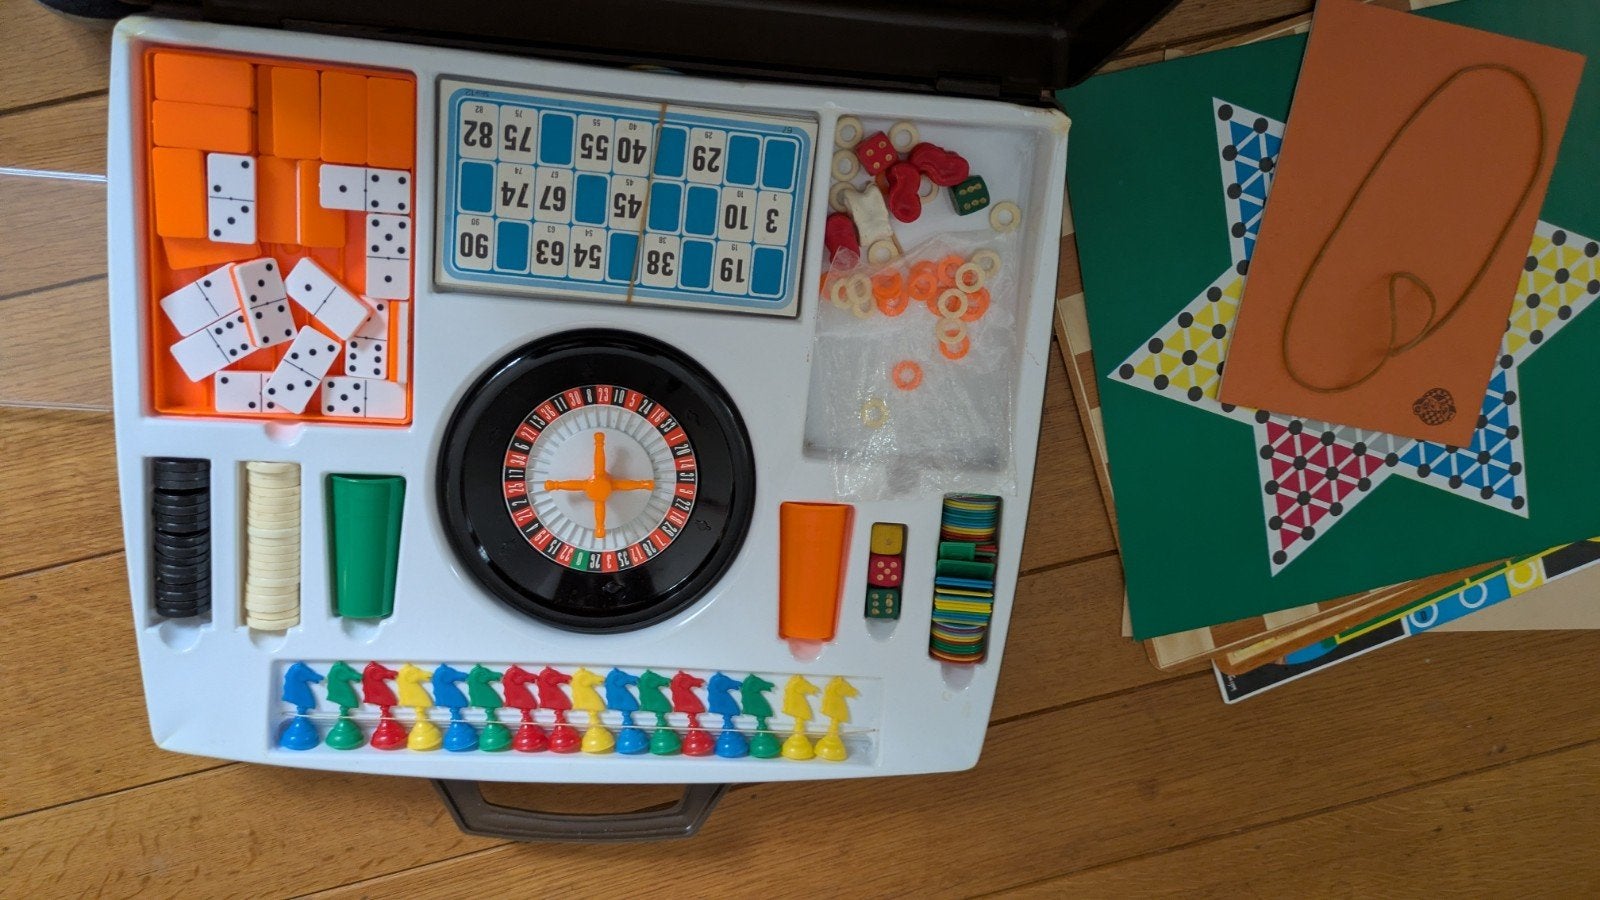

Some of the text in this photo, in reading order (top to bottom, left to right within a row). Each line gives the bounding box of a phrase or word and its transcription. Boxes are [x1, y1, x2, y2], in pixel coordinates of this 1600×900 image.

[463, 120, 493, 148] 82
[504, 124, 531, 152] 75
[581, 133, 609, 161] 55
[617, 137, 647, 165] 40
[693, 145, 721, 173] 29
[501, 181, 529, 208] 74
[539, 186, 566, 212] 67
[614, 193, 643, 221] 45
[725, 204, 748, 230] 10
[766, 209, 779, 233] 3
[460, 232, 488, 259] 90
[536, 240, 564, 266] 63
[574, 243, 602, 269] 54
[647, 250, 674, 276] 38
[720, 258, 744, 283] 19
[569, 390, 581, 406] 30
[586, 388, 593, 403] 8
[598, 388, 609, 401] 23
[614, 389, 625, 403] 10
[629, 393, 636, 406] 5
[541, 405, 556, 419] 36
[555, 398, 567, 412] 11
[639, 399, 653, 414] 24
[529, 414, 546, 428] 13
[651, 408, 665, 423] 16
[659, 418, 676, 432] 33
[521, 426, 537, 440] 27
[514, 442, 530, 450] 6
[674, 444, 691, 455] 20
[510, 455, 526, 465] 34
[508, 469, 524, 478] 17
[679, 472, 695, 482] 31
[508, 482, 524, 492] 25
[674, 498, 691, 510] 22
[515, 508, 533, 521] 21
[661, 521, 678, 536] 29
[547, 539, 561, 555] 15
[642, 540, 657, 556] 28
[655, 535, 667, 547] 7
[560, 545, 574, 561] 32
[618, 552, 629, 566] 35
[631, 547, 643, 562] 12
[590, 554, 600, 568] 26
[607, 554, 612, 568] 3
